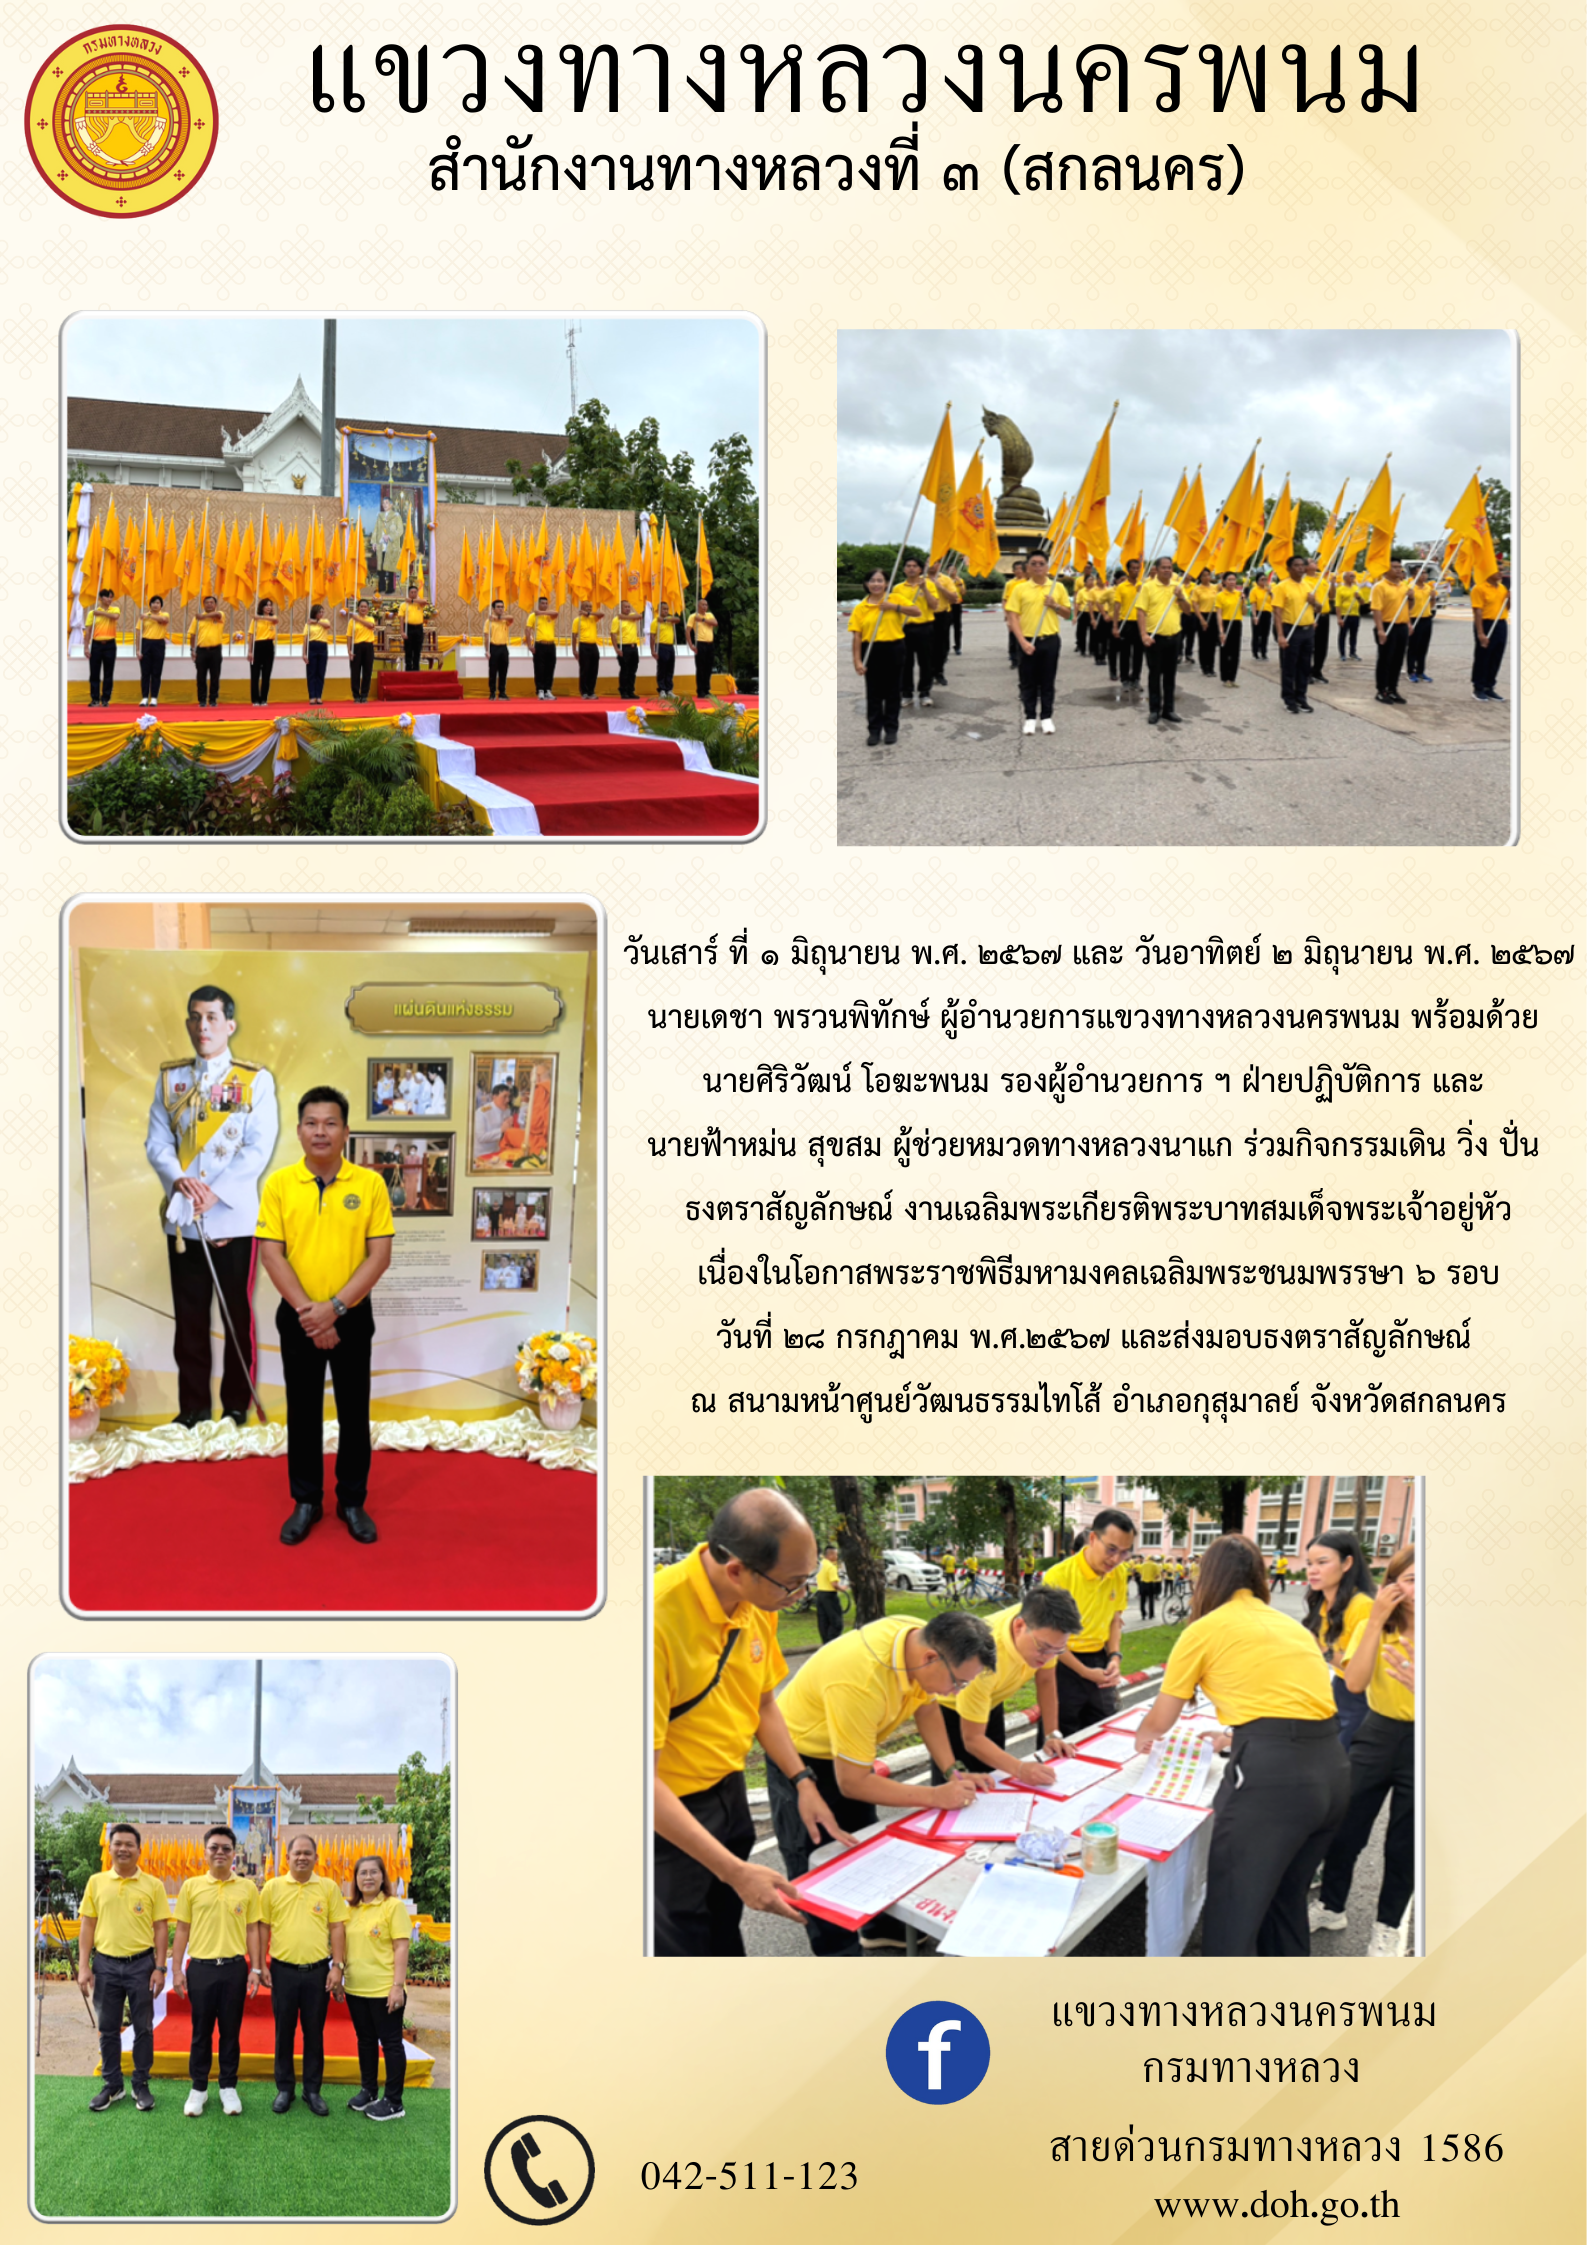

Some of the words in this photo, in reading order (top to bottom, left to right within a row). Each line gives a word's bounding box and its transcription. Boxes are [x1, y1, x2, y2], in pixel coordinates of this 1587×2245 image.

[393, 999, 514, 1018] แผ่นดินแห่งธรรม
